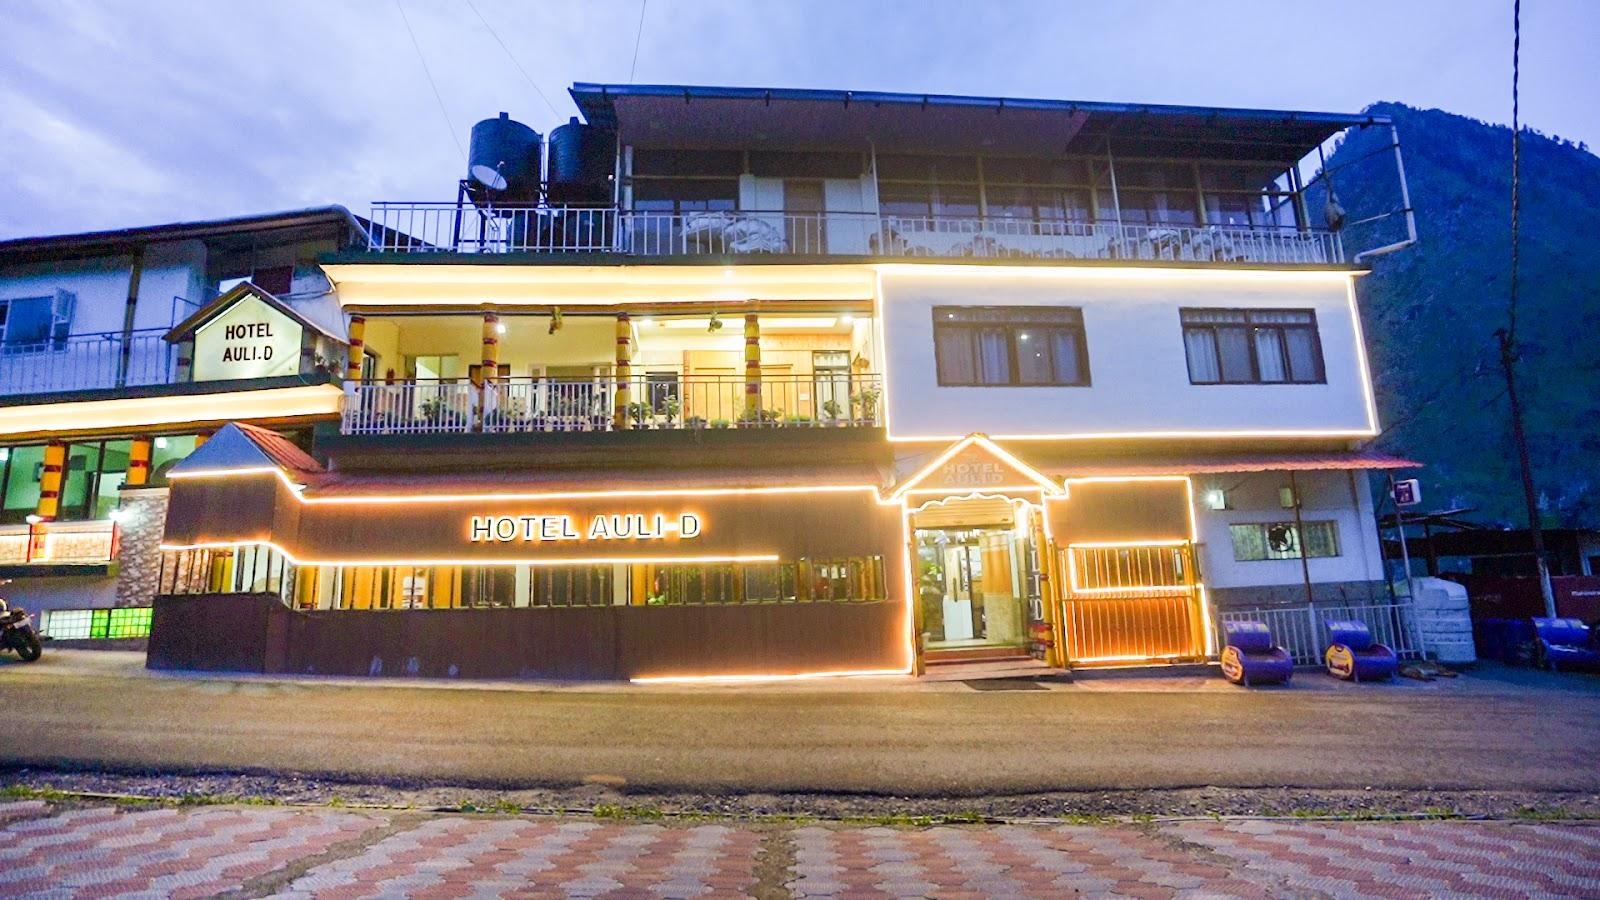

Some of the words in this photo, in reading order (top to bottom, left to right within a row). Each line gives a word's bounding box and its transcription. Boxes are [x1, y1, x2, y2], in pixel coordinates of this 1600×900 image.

[225, 323, 273, 339] HOTEL
[943, 462, 1004, 474] HOTEL
[471, 514, 580, 542] HOTEL
[588, 512, 701, 540] AULI-D
